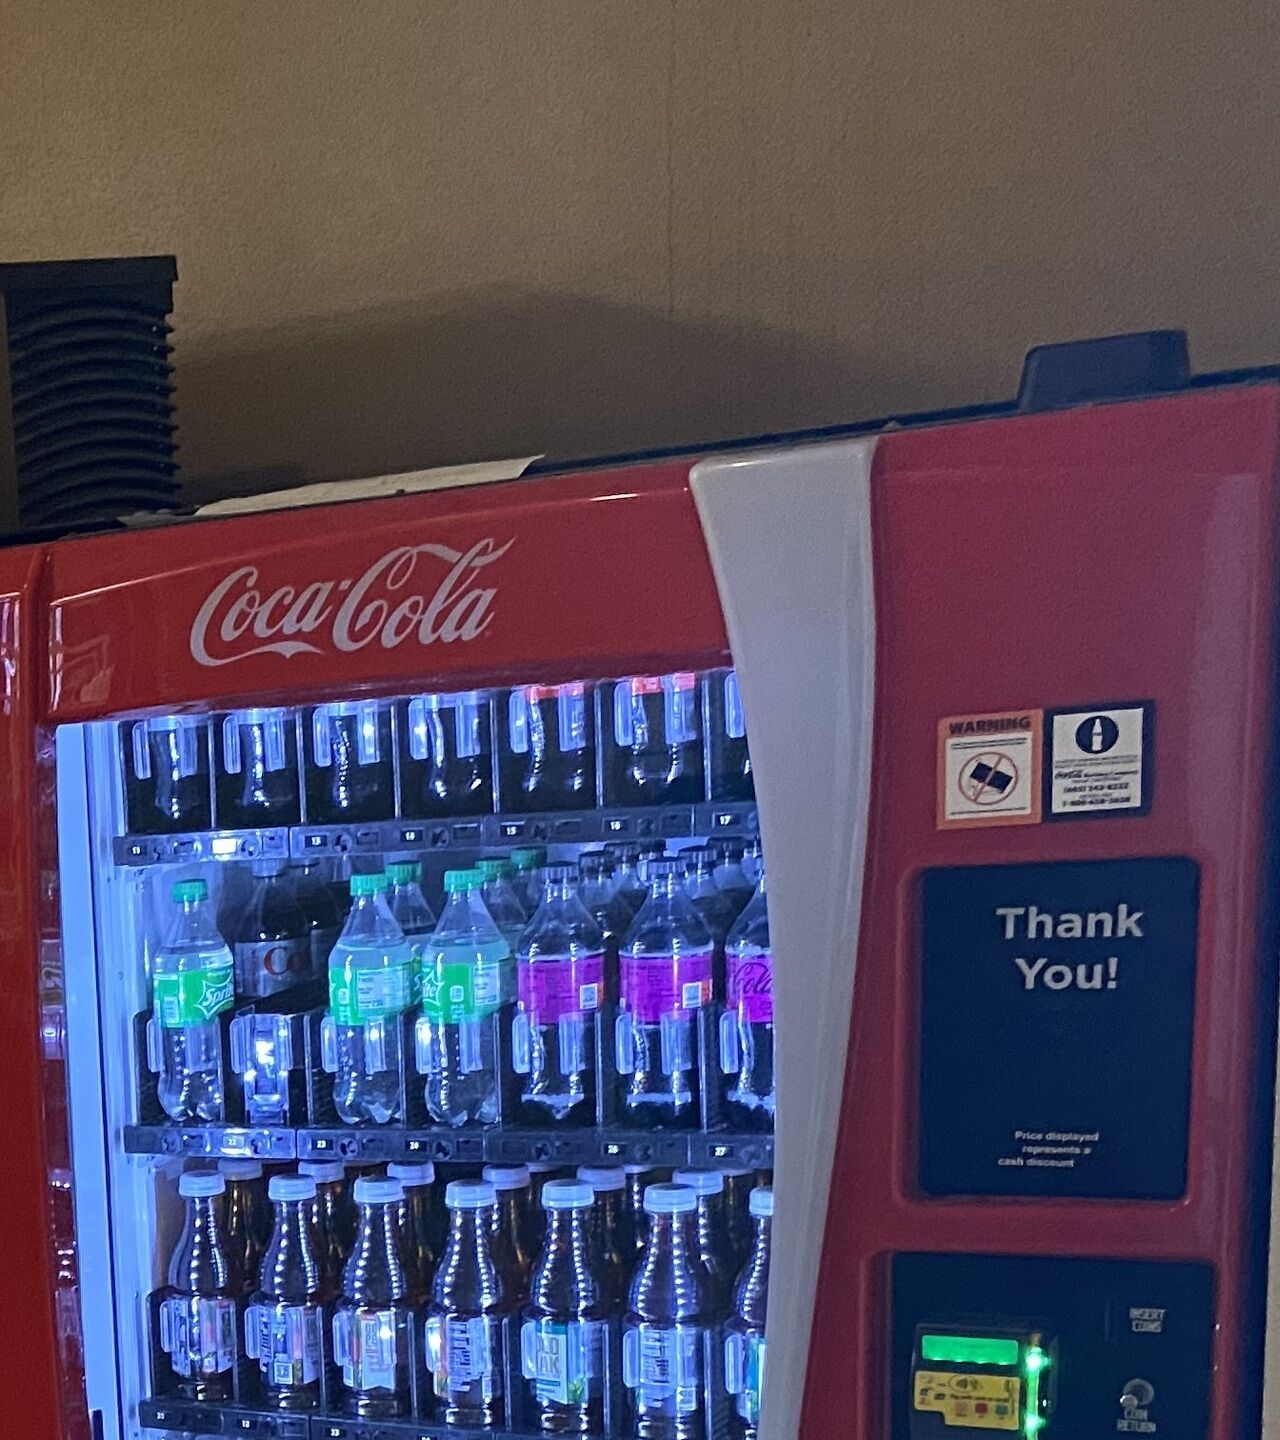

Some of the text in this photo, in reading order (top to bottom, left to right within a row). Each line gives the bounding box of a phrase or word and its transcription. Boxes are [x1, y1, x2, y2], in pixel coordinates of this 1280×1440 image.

[190, 537, 516, 666] Coca-Cola
[949, 717, 1031, 734] WARNING
[995, 903, 1144, 939] Thank
[1014, 957, 1118, 990] You!
[1014, 1130, 1043, 1140] Price
